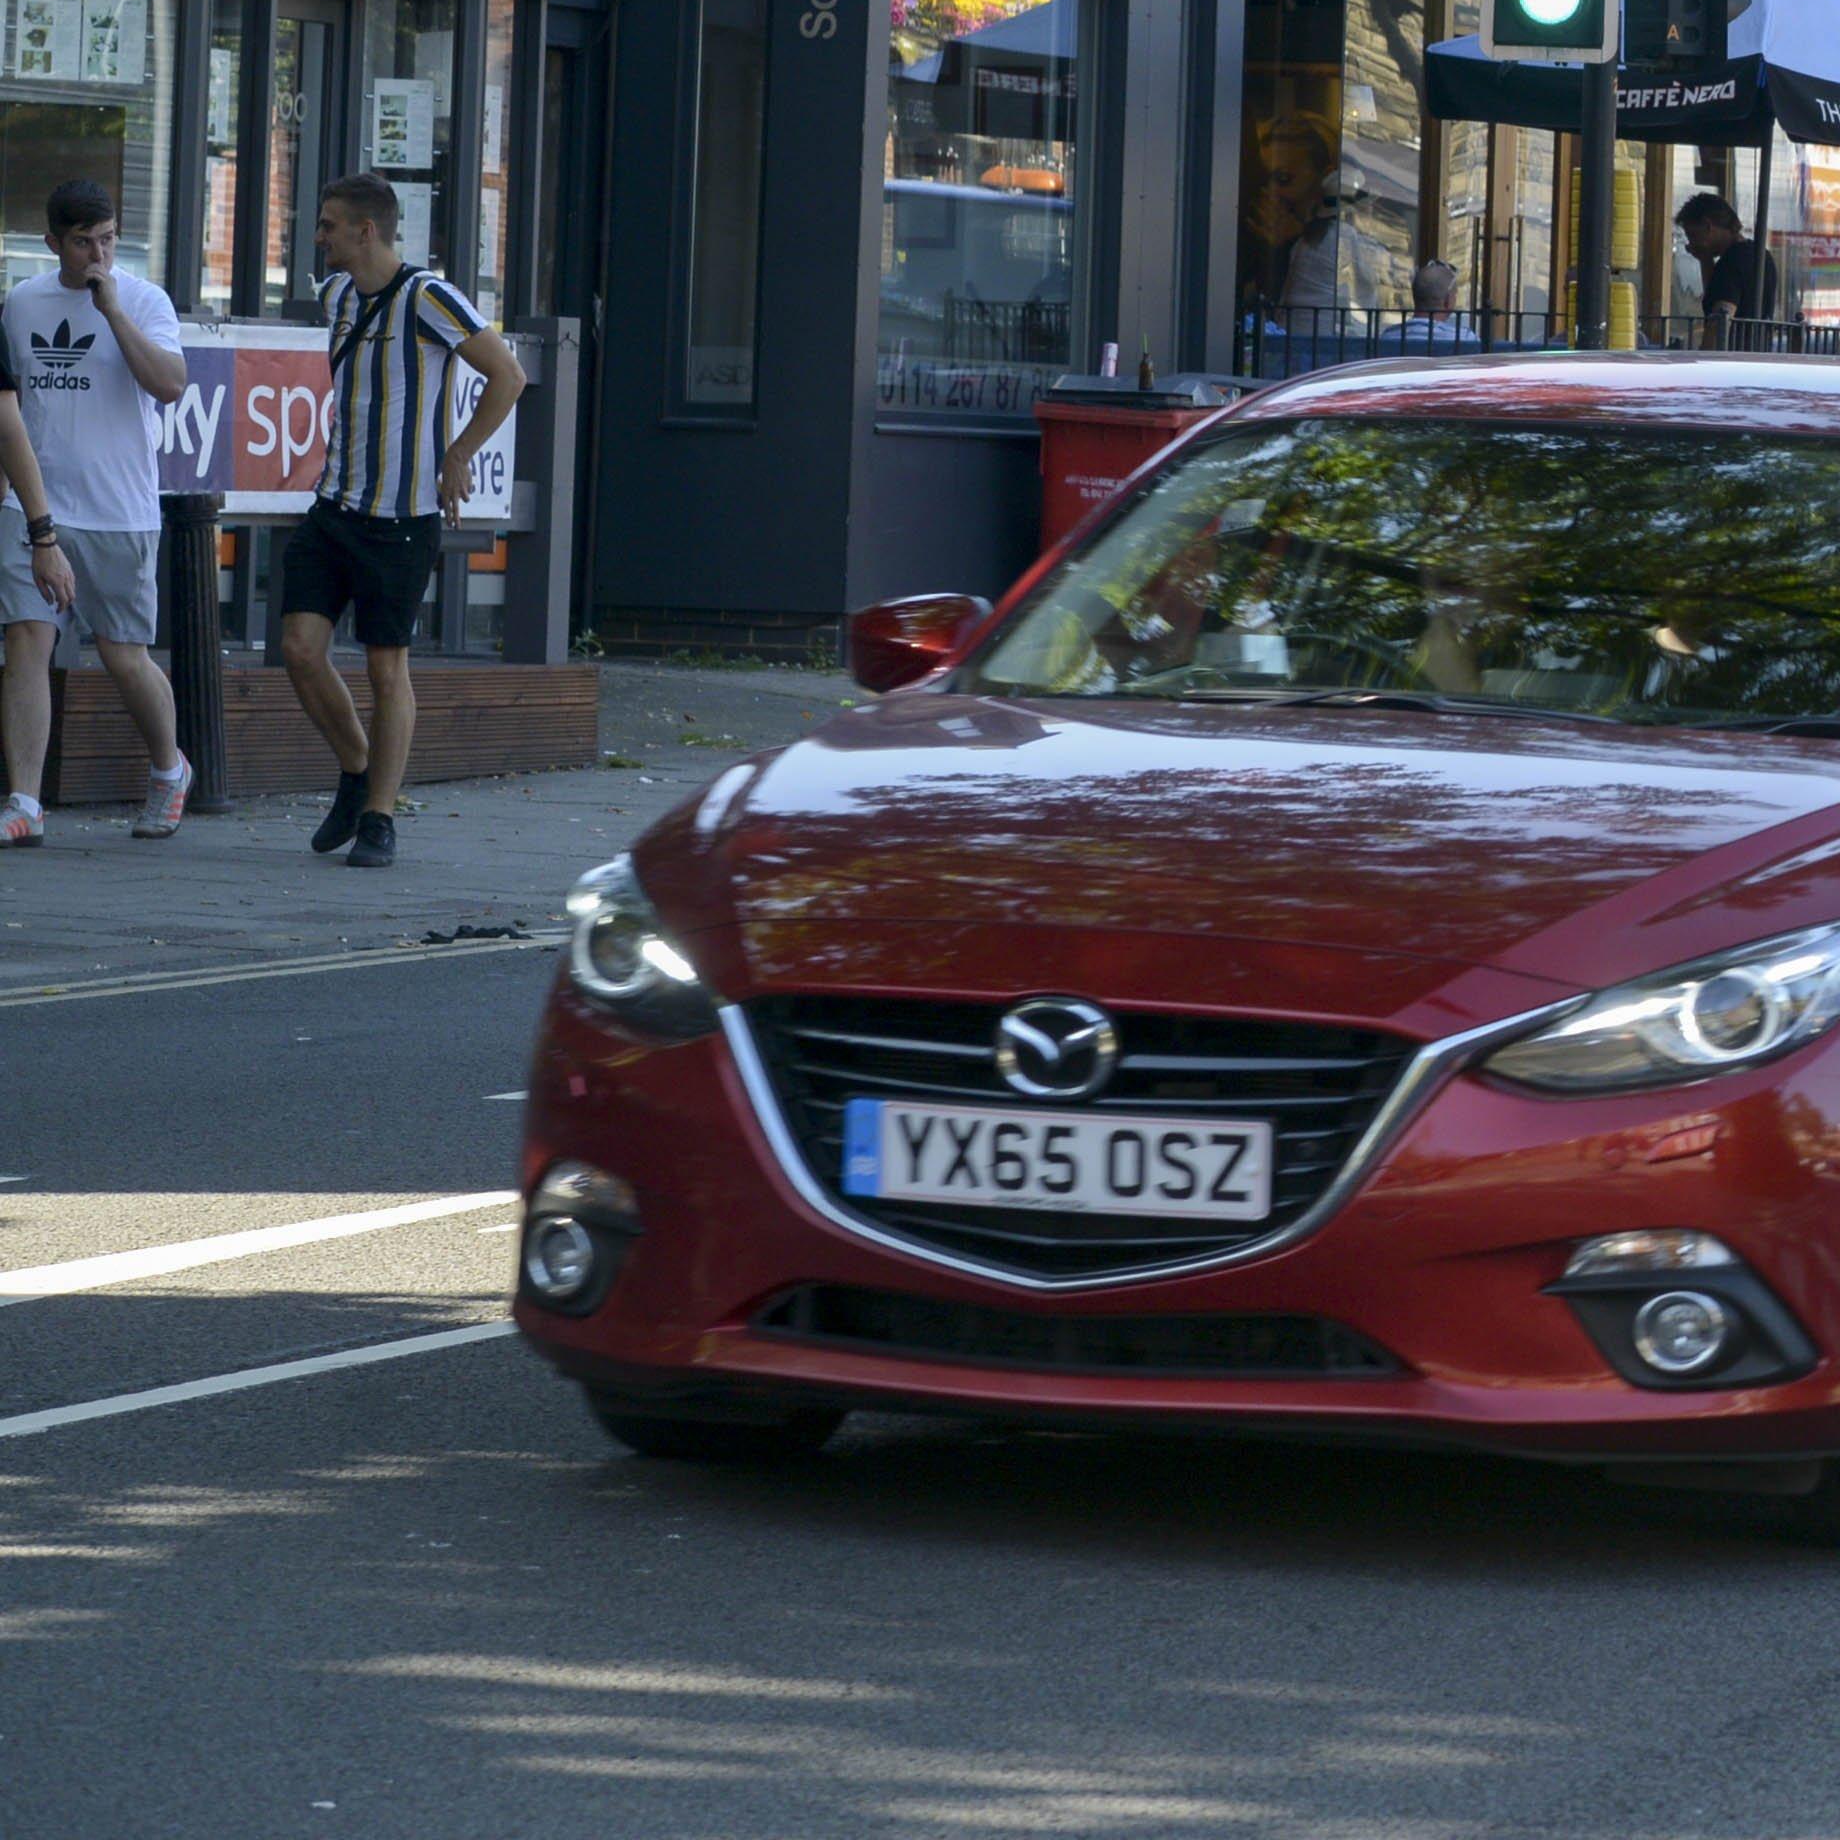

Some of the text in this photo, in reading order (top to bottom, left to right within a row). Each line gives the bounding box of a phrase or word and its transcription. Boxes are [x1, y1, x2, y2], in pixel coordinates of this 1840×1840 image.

[1667, 24, 1680, 40] A
[1682, 80, 1735, 106] NERO
[29, 371, 91, 391] adidas
[898, 1113, 1250, 1203] YX65 OSZ
